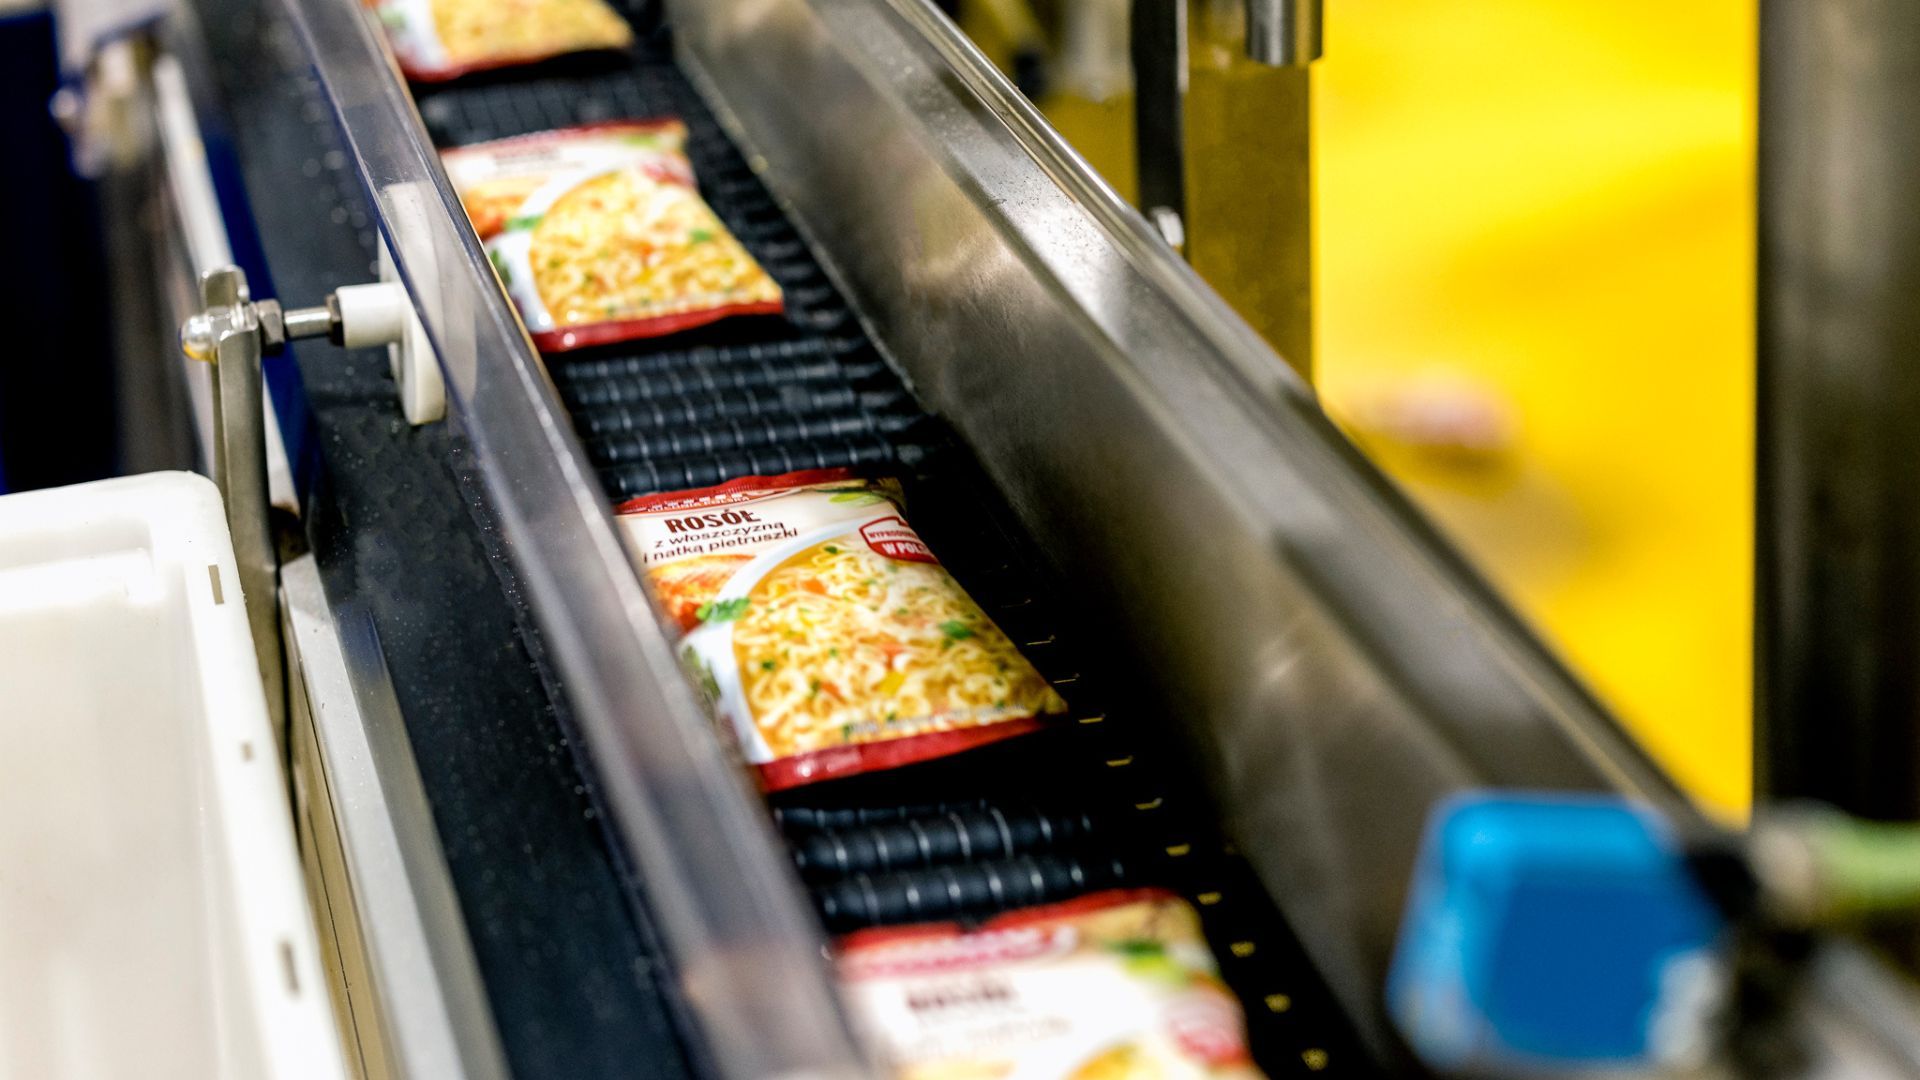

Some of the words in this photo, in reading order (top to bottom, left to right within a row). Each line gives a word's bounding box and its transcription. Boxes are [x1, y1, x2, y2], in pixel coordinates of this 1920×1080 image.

[664, 508, 762, 533] ROSÓŁ
[643, 553, 648, 564] i
[653, 544, 705, 561] natką
[709, 527, 799, 552] pietruszki
[655, 539, 664, 548] z
[669, 521, 785, 545] włoszczyzną
[882, 542, 897, 555] W
